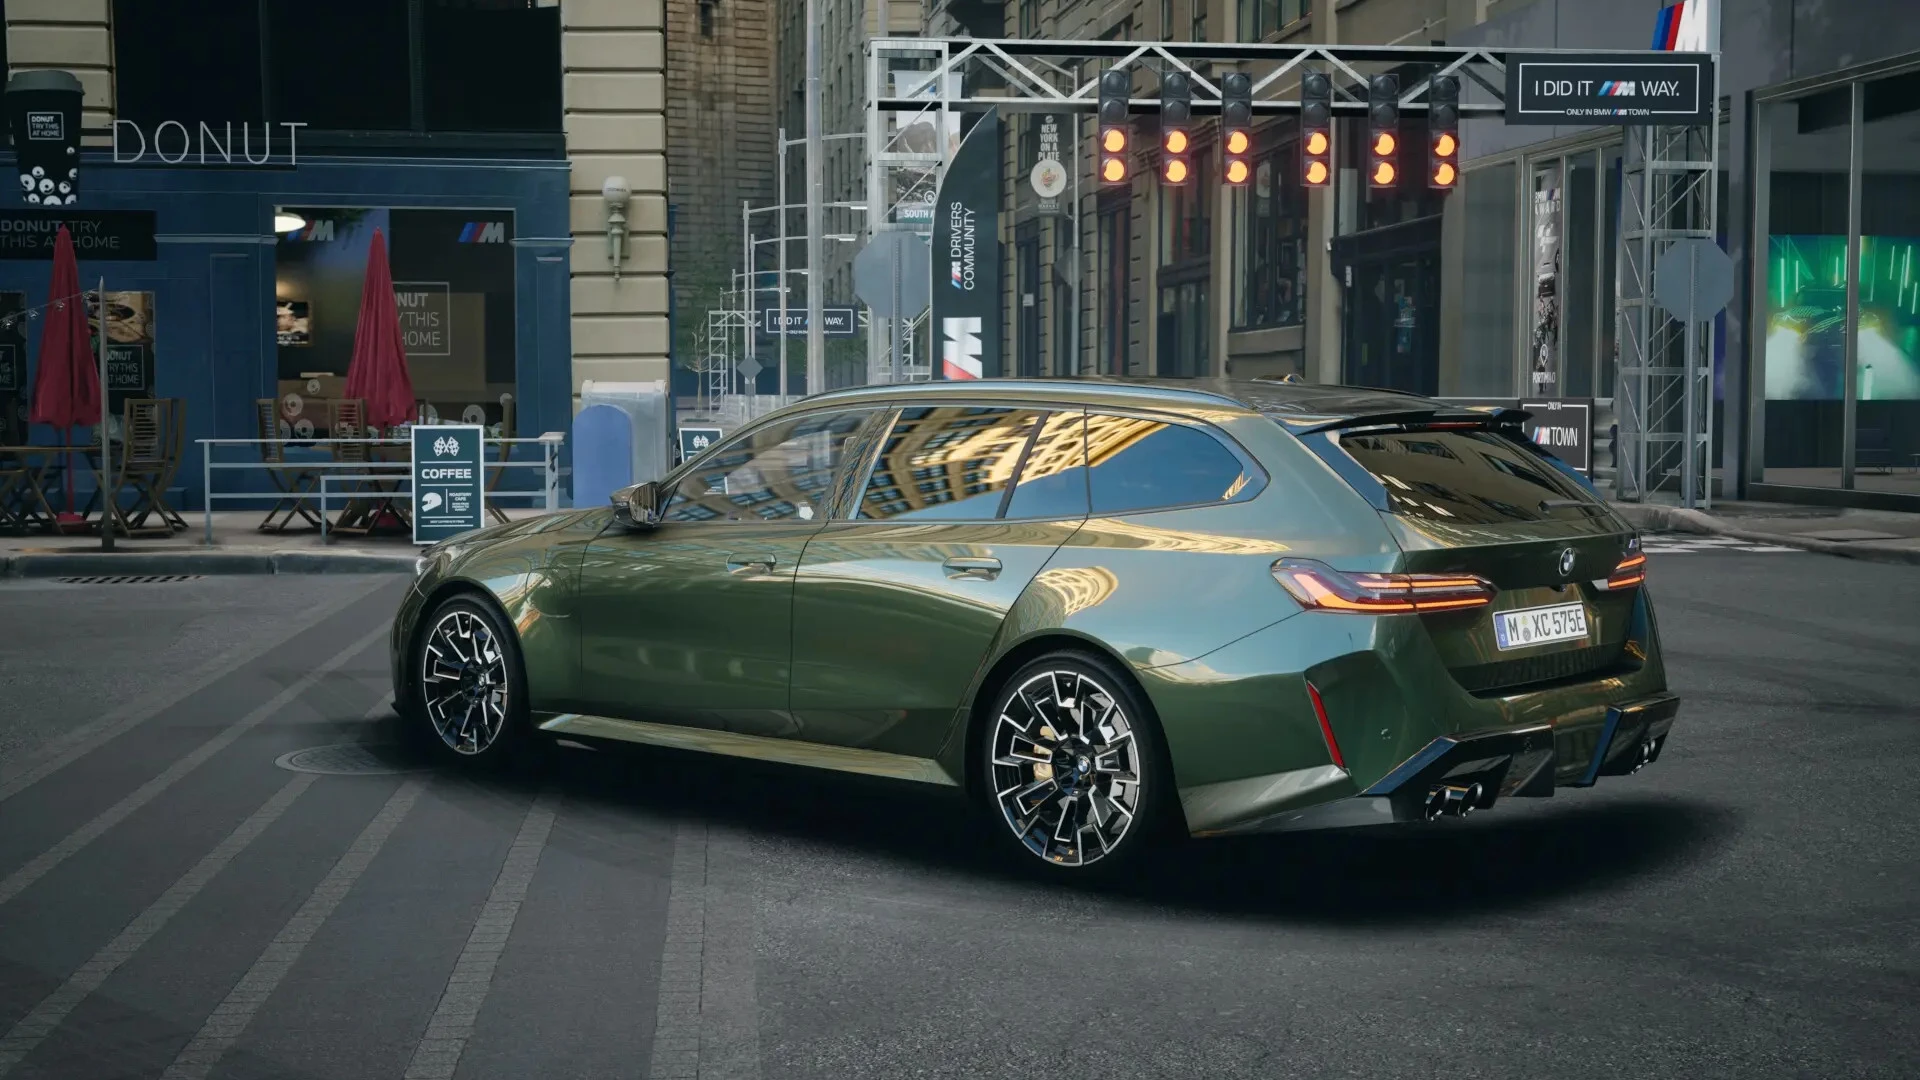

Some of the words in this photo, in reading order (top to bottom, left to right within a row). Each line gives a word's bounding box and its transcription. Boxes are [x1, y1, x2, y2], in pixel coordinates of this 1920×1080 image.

[1535, 80, 1539, 96] I
[1543, 80, 1573, 96] DID
[1578, 80, 1594, 96] IT
[1641, 80, 1680, 97] WAY.
[1566, 108, 1585, 116] ONLY
[1585, 108, 1593, 116] IN
[1593, 108, 1612, 116] BMW
[1628, 108, 1650, 116] TOWN
[1041, 123, 1057, 133] NEW
[113, 119, 308, 166] DONUT
[1040, 133, 1059, 142] YORK
[1040, 142, 1051, 151] ON
[1052, 142, 1058, 151] A
[1038, 151, 1060, 161] PLATE
[904, 209, 928, 218] SOUTH
[0, 220, 63, 232] DONUT
[67, 220, 102, 233] TRY
[950, 201, 963, 258] DRIVERS
[0, 235, 37, 248] THIS
[963, 207, 976, 291] COMMUNITY
[405, 311, 440, 327] THIS
[794, 316, 802, 325] IT
[824, 316, 844, 325] WAY.
[1550, 426, 1578, 446] TOWN
[421, 468, 472, 479] COFFEE
[1507, 617, 1520, 641] M
[1531, 613, 1551, 638] XC
[1551, 608, 1585, 635] 575E
